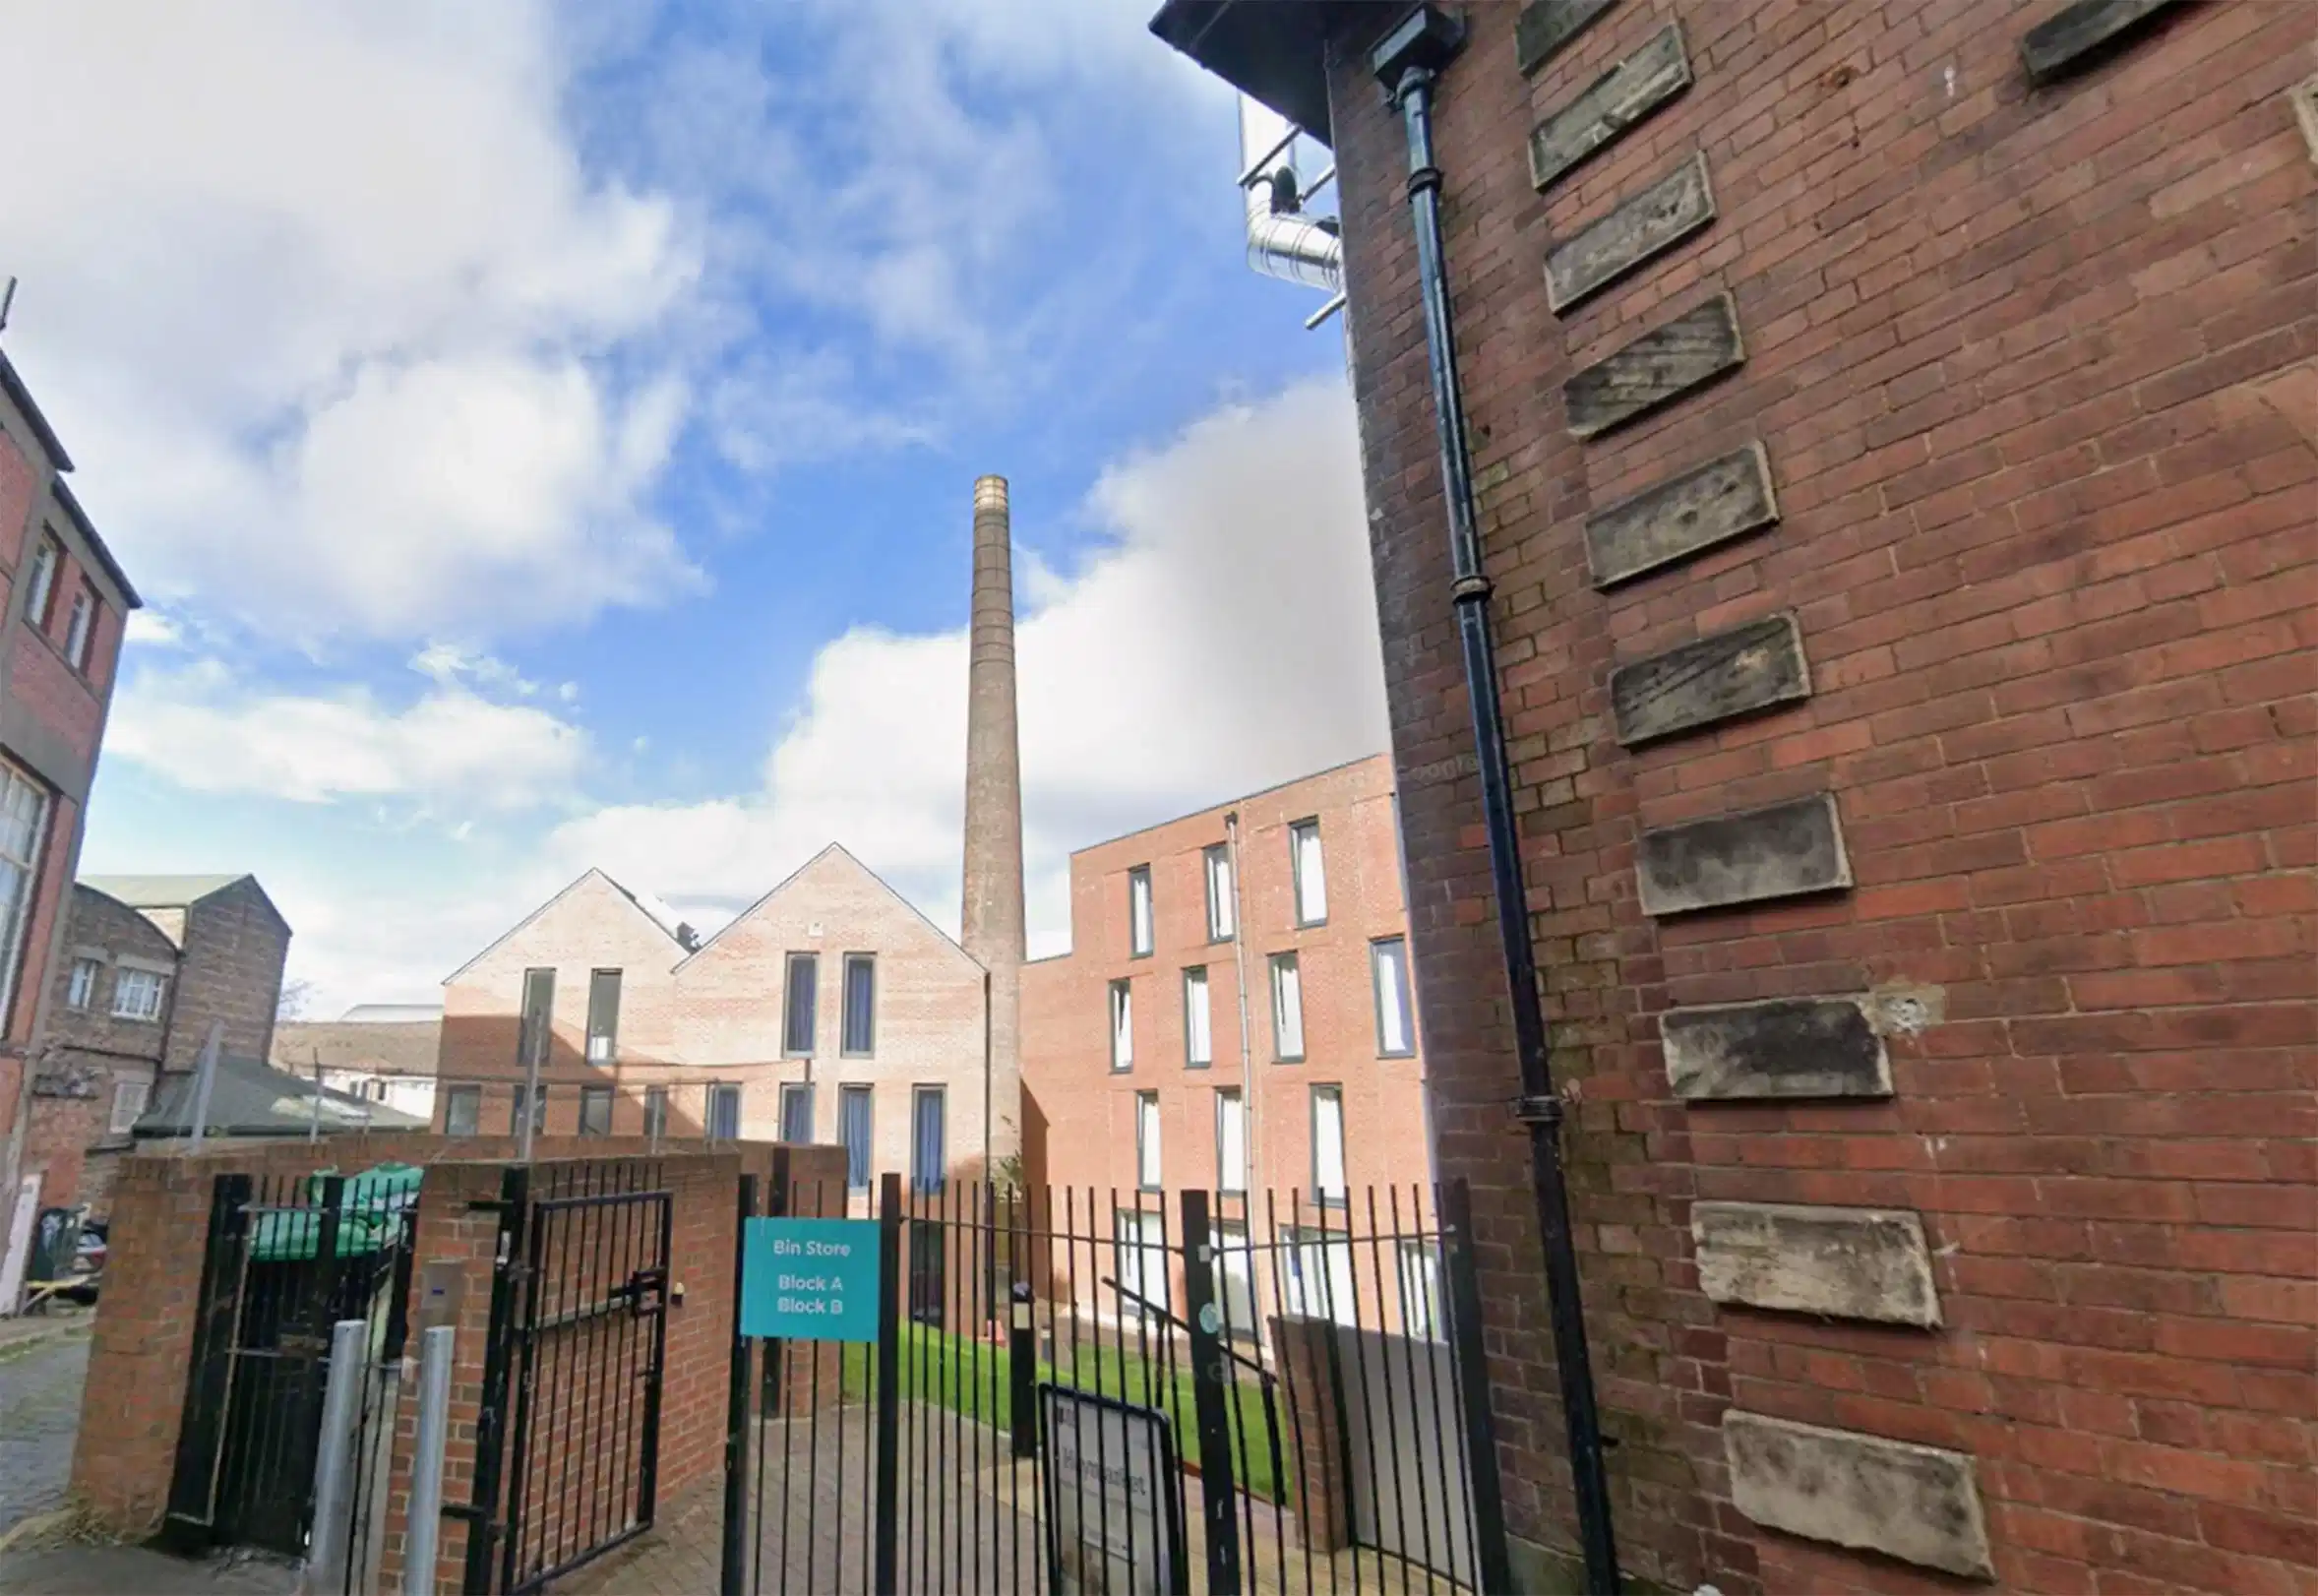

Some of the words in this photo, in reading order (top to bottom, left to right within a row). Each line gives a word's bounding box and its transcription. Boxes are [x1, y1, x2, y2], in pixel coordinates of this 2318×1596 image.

[773, 1239, 801, 1256] Bin
[806, 1241, 851, 1257] Store
[778, 1274, 825, 1292] Block
[830, 1276, 843, 1292] A
[777, 1298, 825, 1315] Block
[830, 1299, 843, 1315] B
